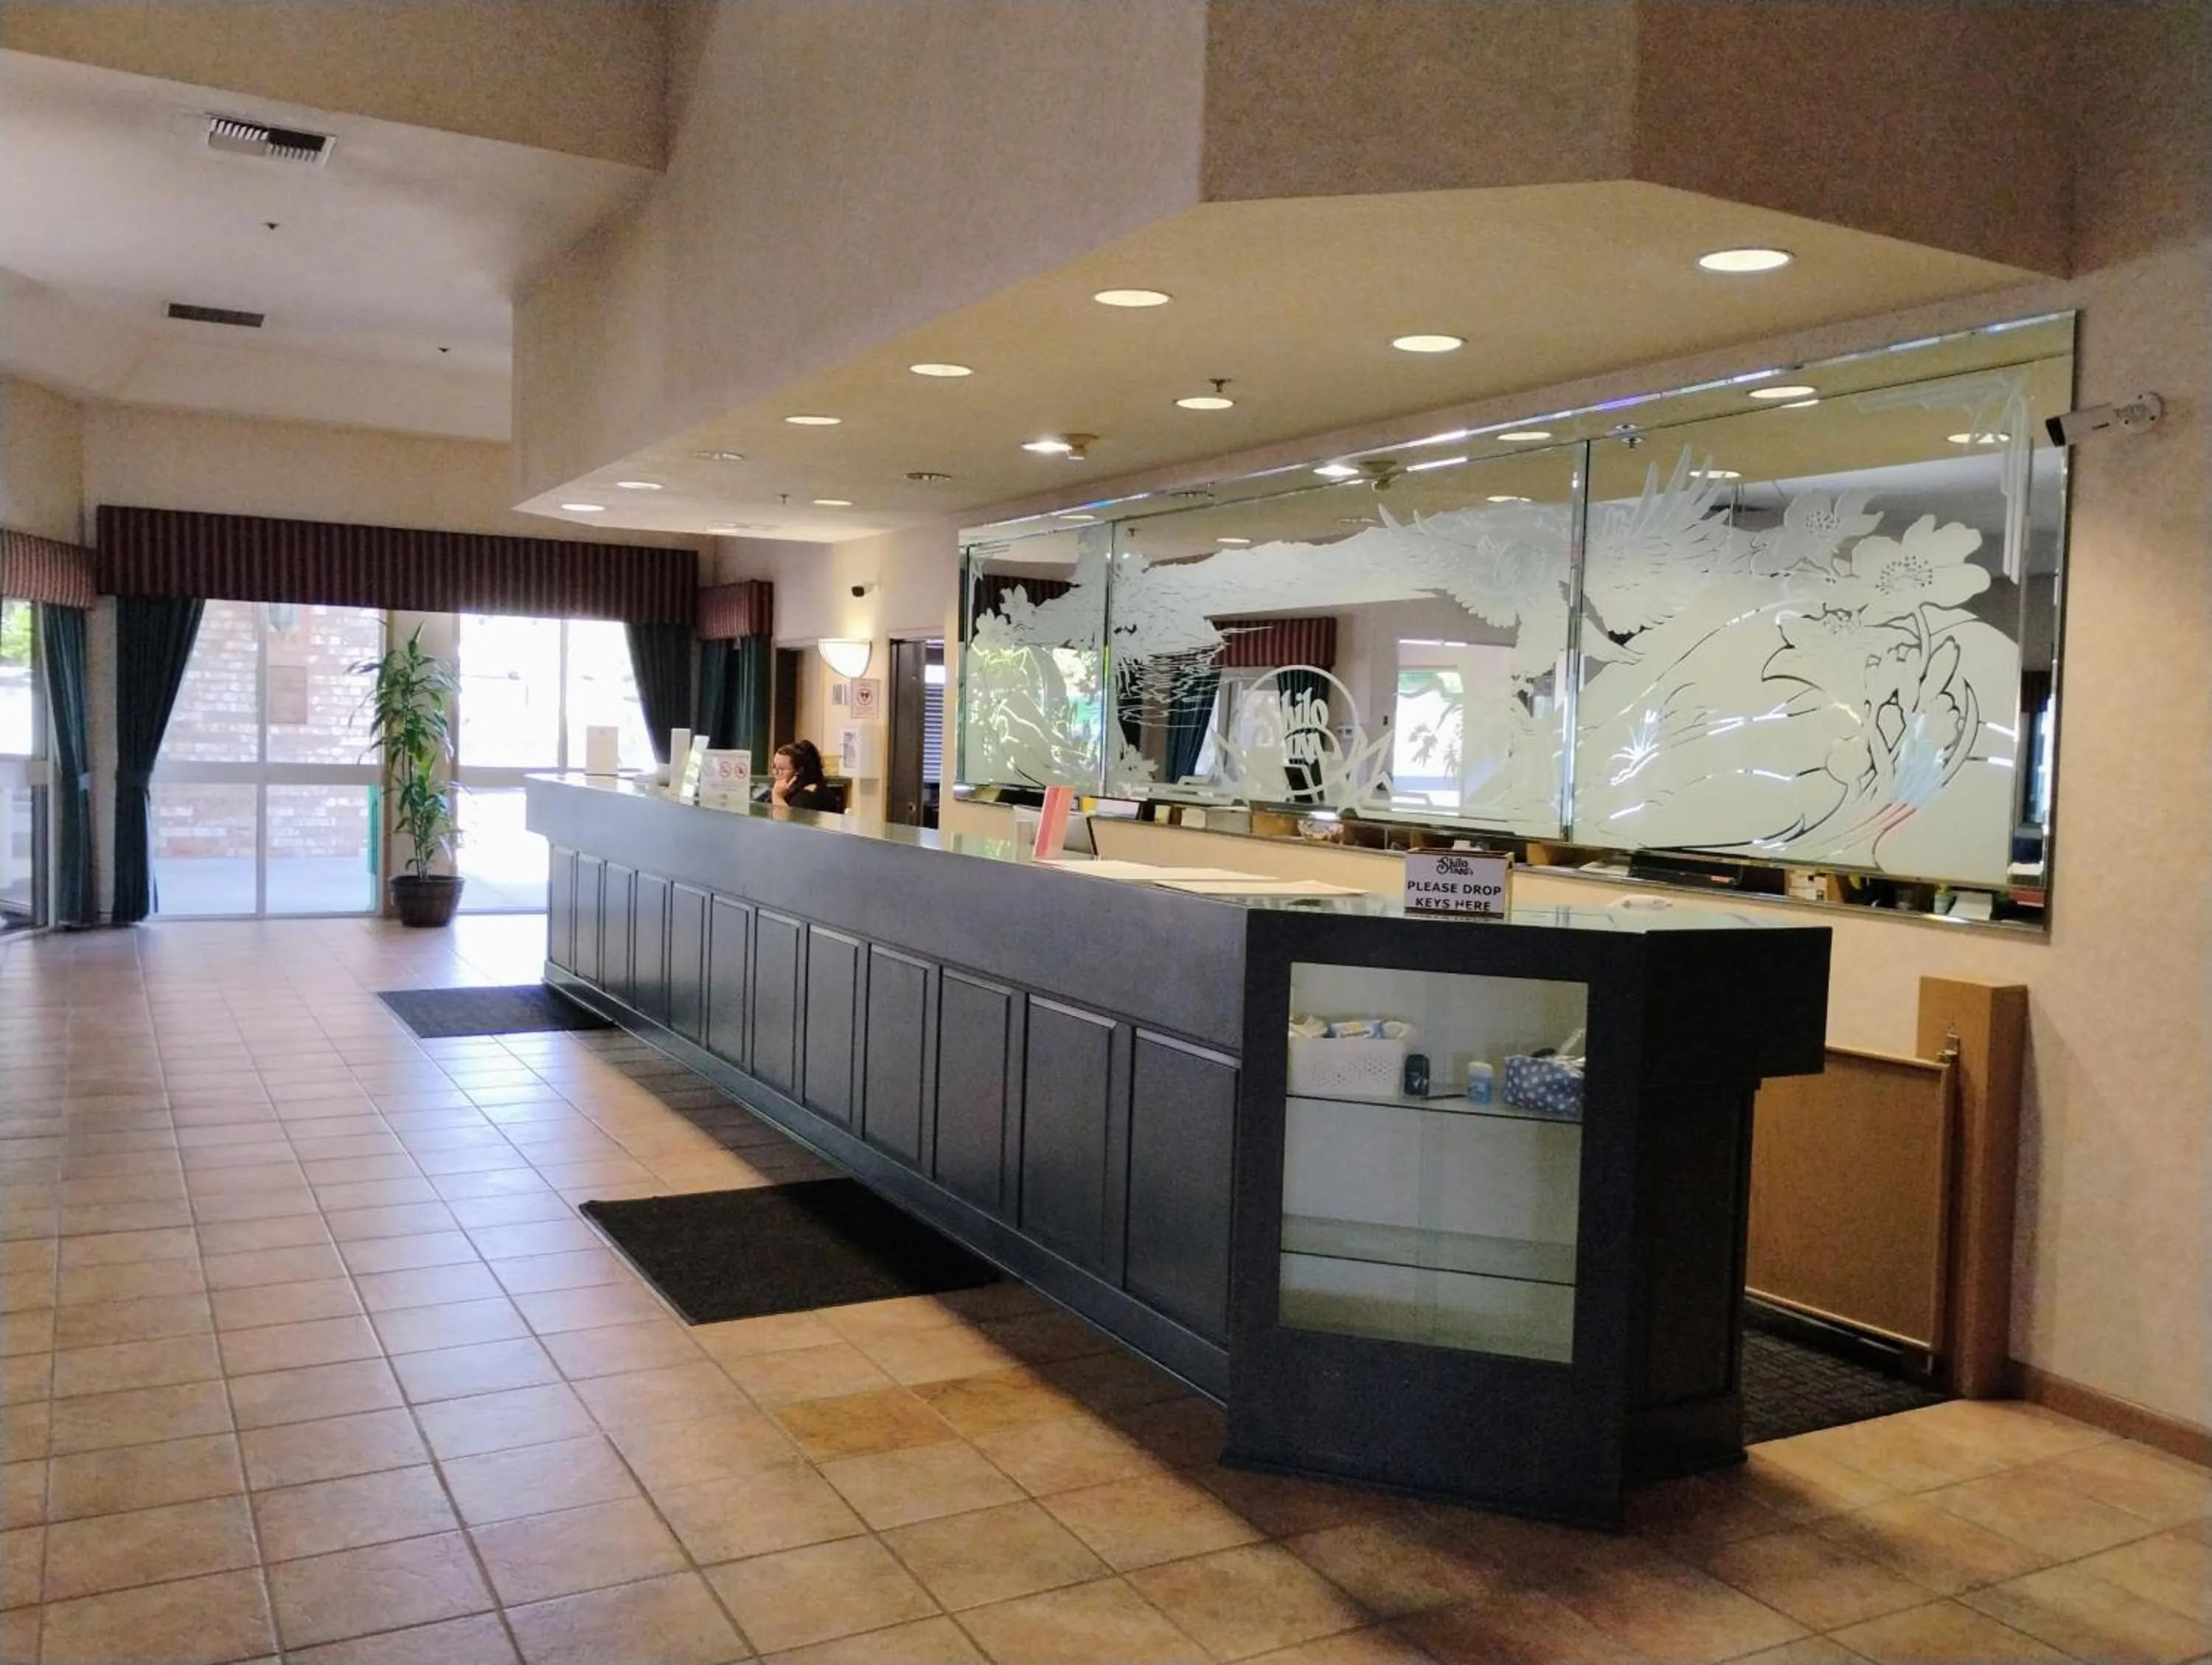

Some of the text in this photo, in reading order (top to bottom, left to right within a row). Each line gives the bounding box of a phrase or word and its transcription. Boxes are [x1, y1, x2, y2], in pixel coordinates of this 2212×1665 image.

[1408, 880, 1501, 896] PLEASE DROP
[1416, 897, 1491, 911] KEYS HERE
